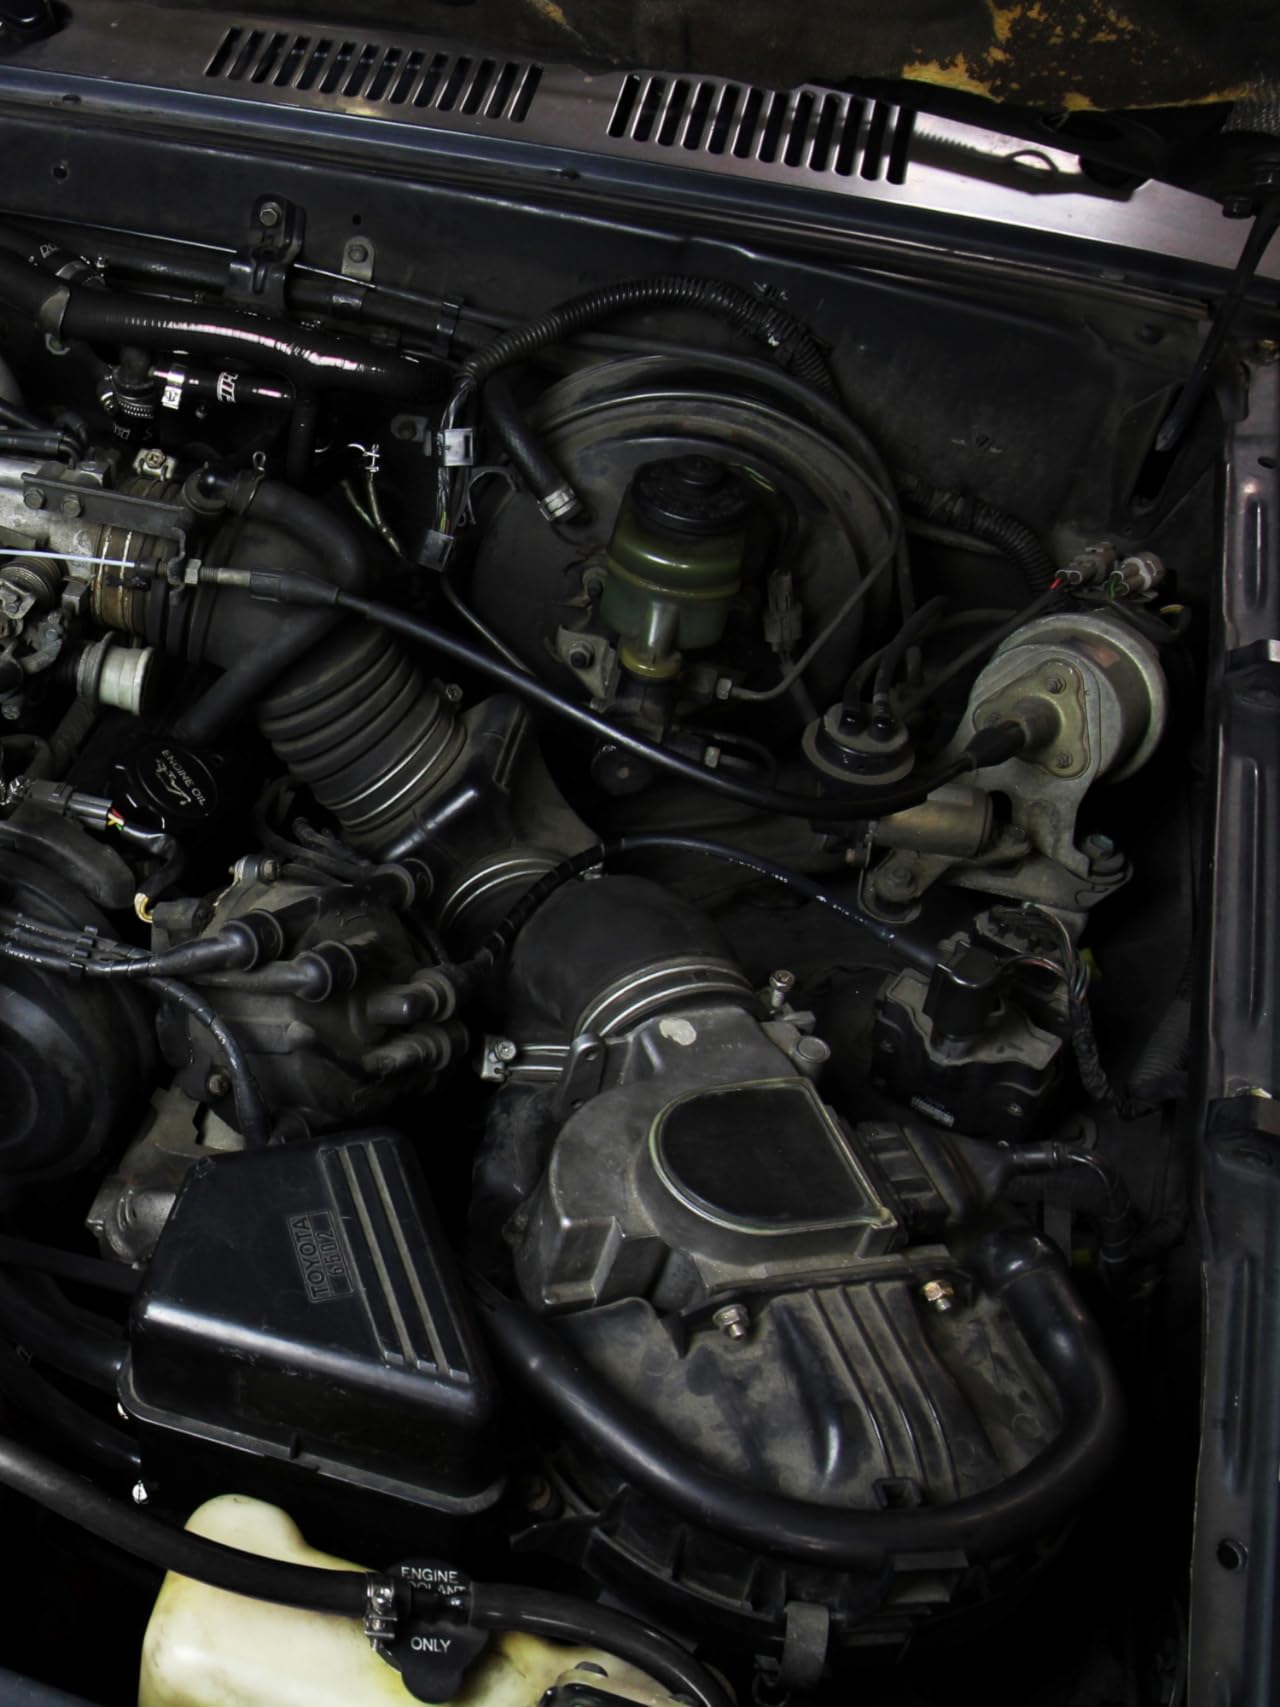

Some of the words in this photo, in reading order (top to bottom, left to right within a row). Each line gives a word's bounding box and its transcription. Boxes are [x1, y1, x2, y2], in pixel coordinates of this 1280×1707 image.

[161, 750, 194, 788] ENGINE
[191, 788, 206, 806] OIL
[292, 1217, 329, 1298] TOYOTA
[401, 1566, 459, 1584] ENGINE
[410, 1636, 451, 1653] ONLY
